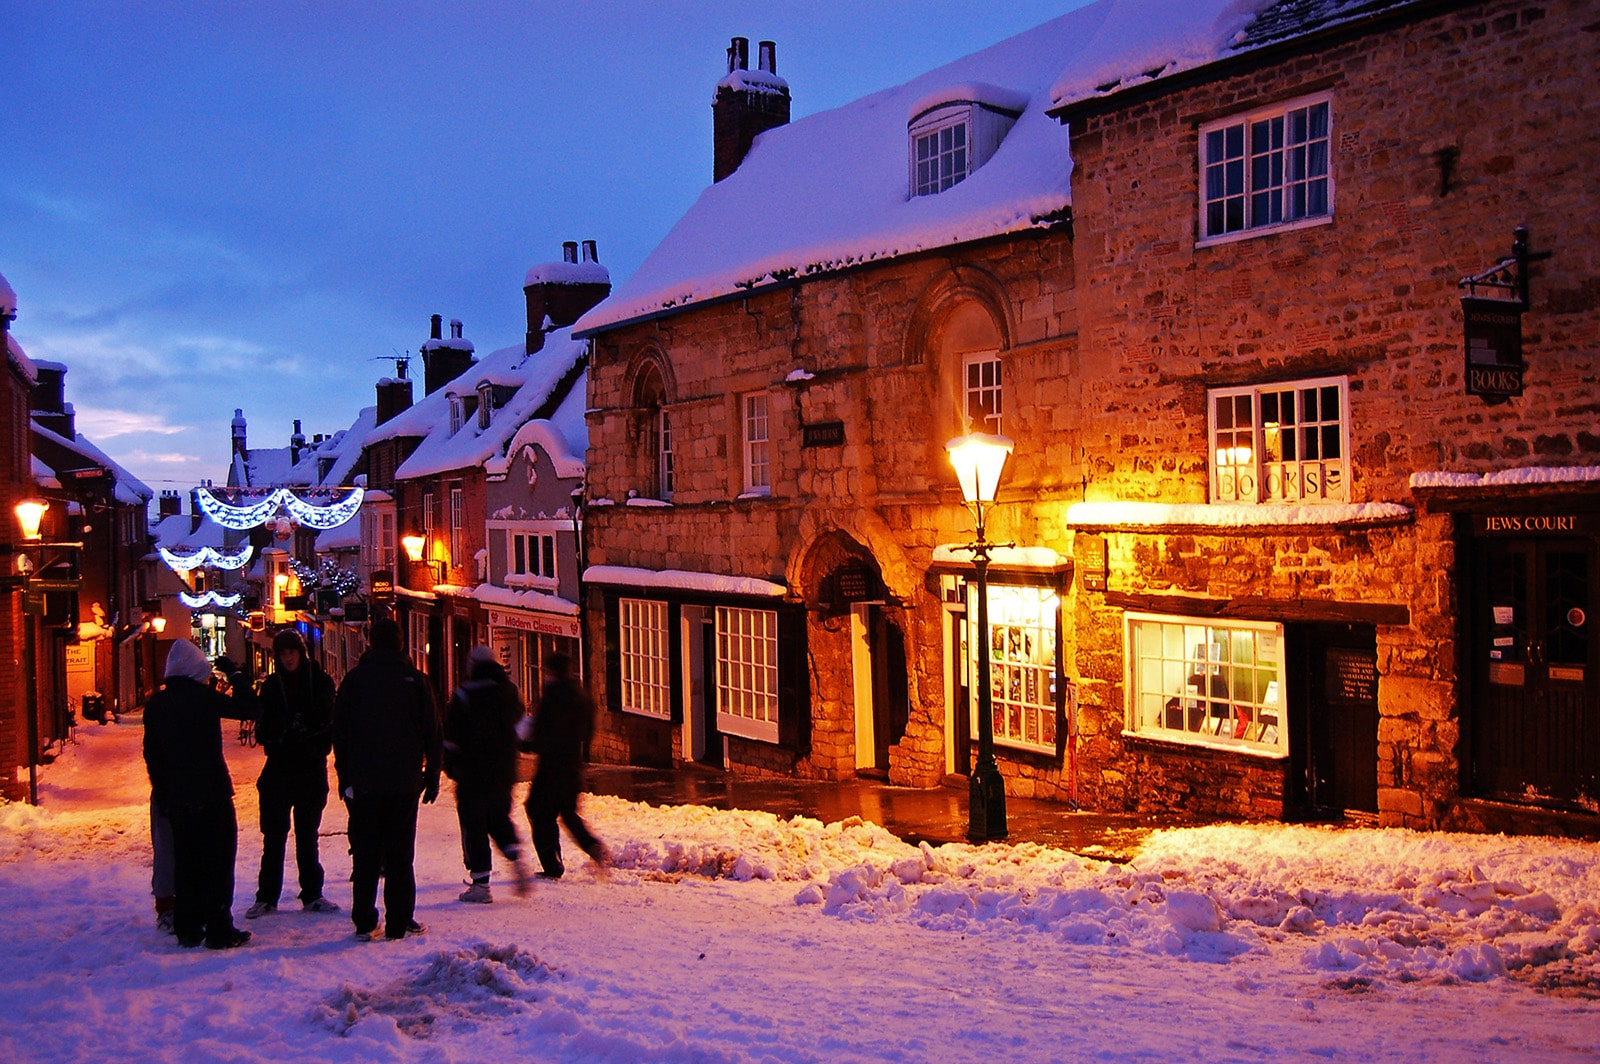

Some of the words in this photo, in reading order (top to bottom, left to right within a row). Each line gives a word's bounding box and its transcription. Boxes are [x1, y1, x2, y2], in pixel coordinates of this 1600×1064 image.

[1470, 370, 1519, 391] BOOKS
[1221, 472, 1318, 496] BOOKS
[1486, 517, 1521, 531] JEWS
[1525, 516, 1577, 531] COURT
[505, 616, 532, 629] Modern
[533, 619, 563, 634] Classics
